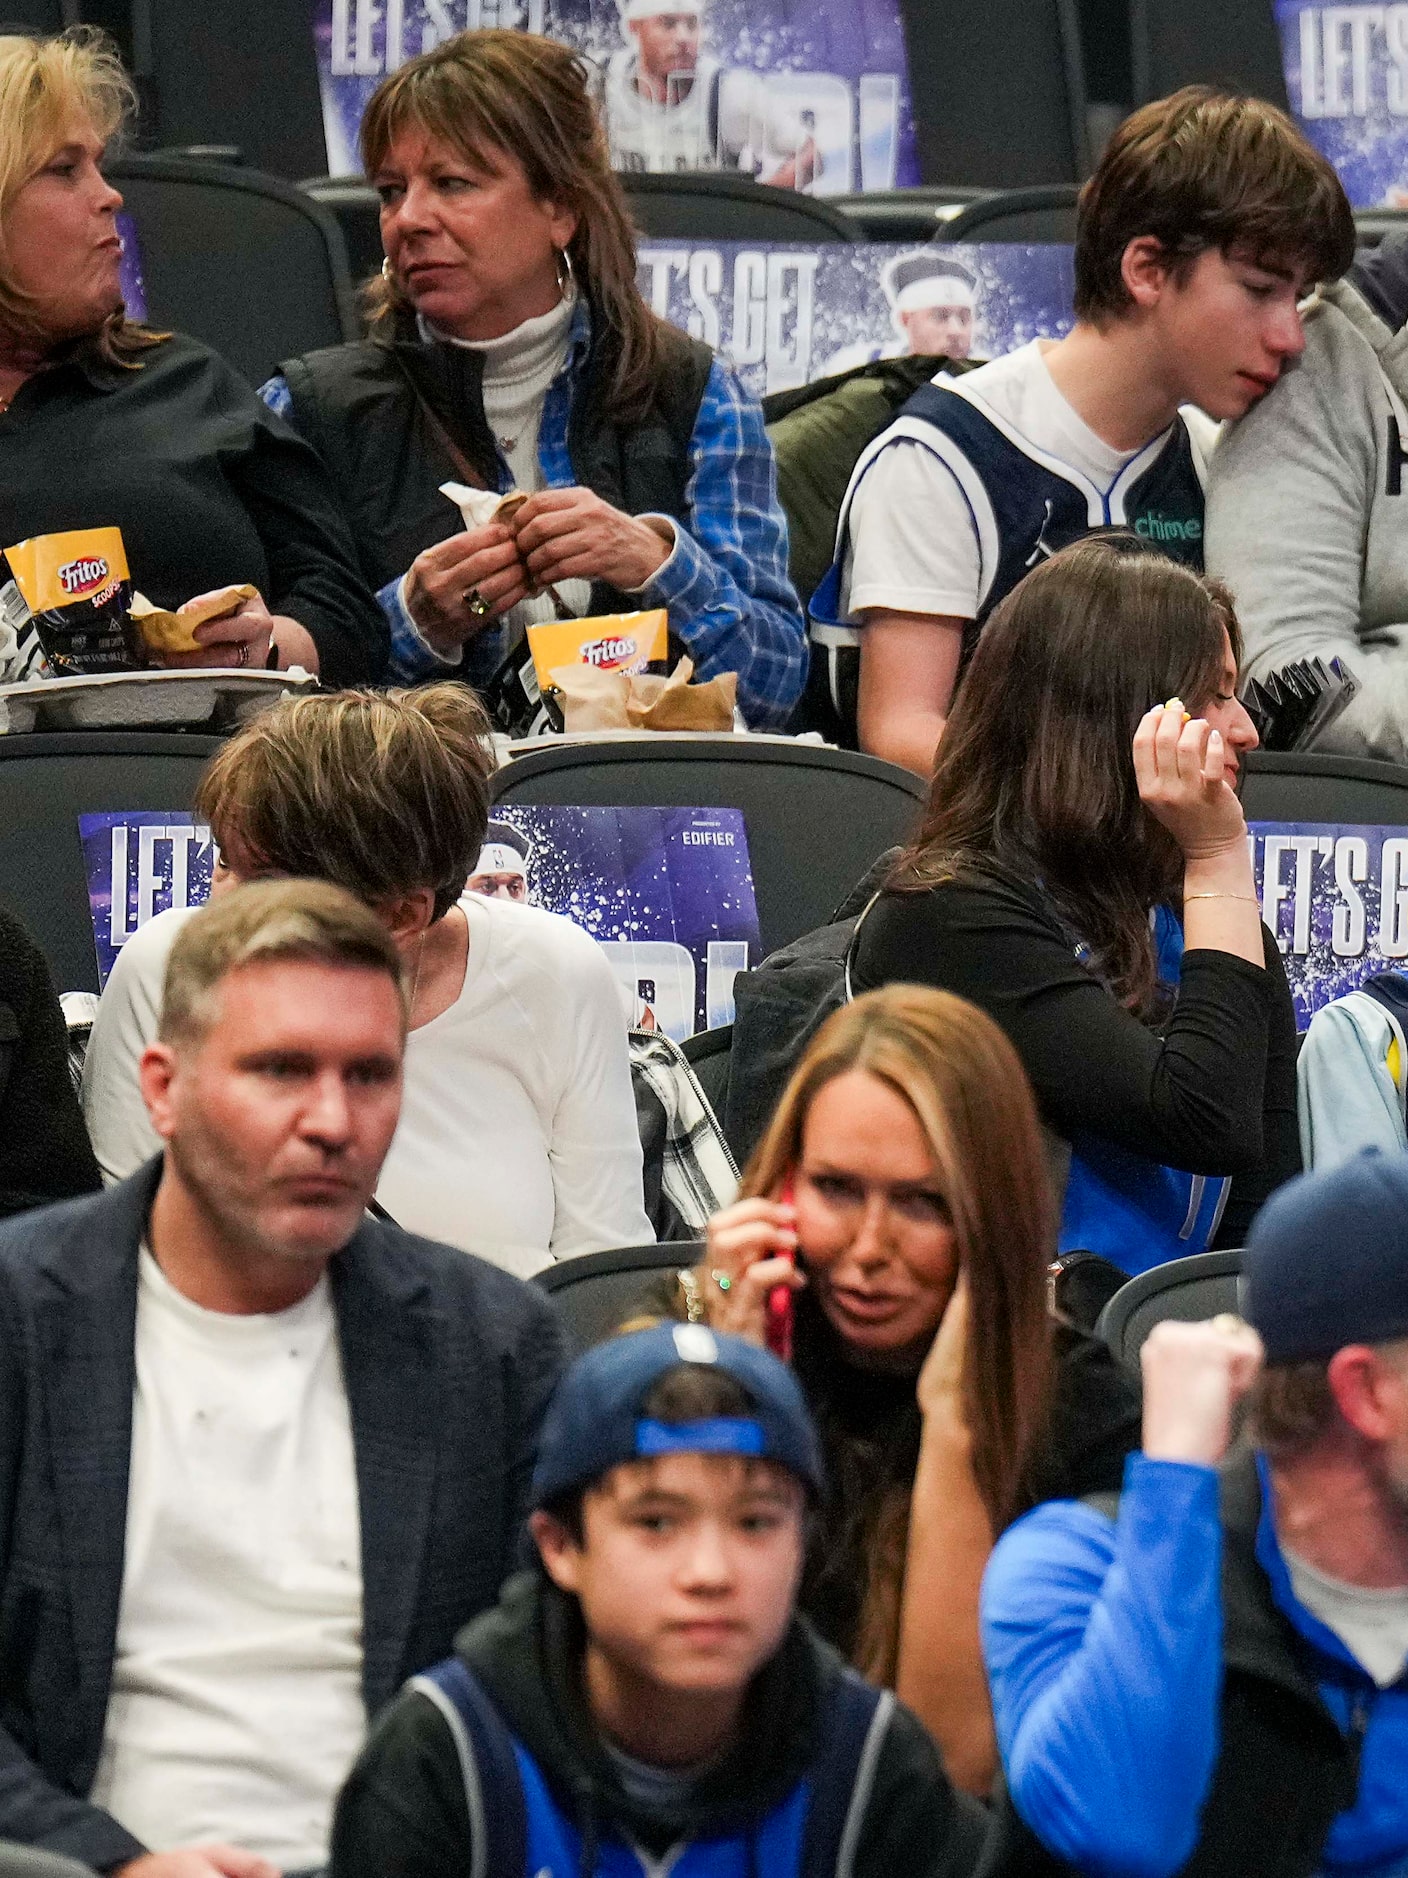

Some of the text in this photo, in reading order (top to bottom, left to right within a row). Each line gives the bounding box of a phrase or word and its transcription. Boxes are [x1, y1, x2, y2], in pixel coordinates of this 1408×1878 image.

[734, 251, 819, 366] GET
[1135, 511, 1202, 540] chime
[57, 558, 107, 592] Fritos
[579, 638, 637, 665] Fritos
[682, 831, 735, 846] EDIFIER
[111, 826, 214, 946] LET'
[1247, 835, 1368, 957] ET'S
